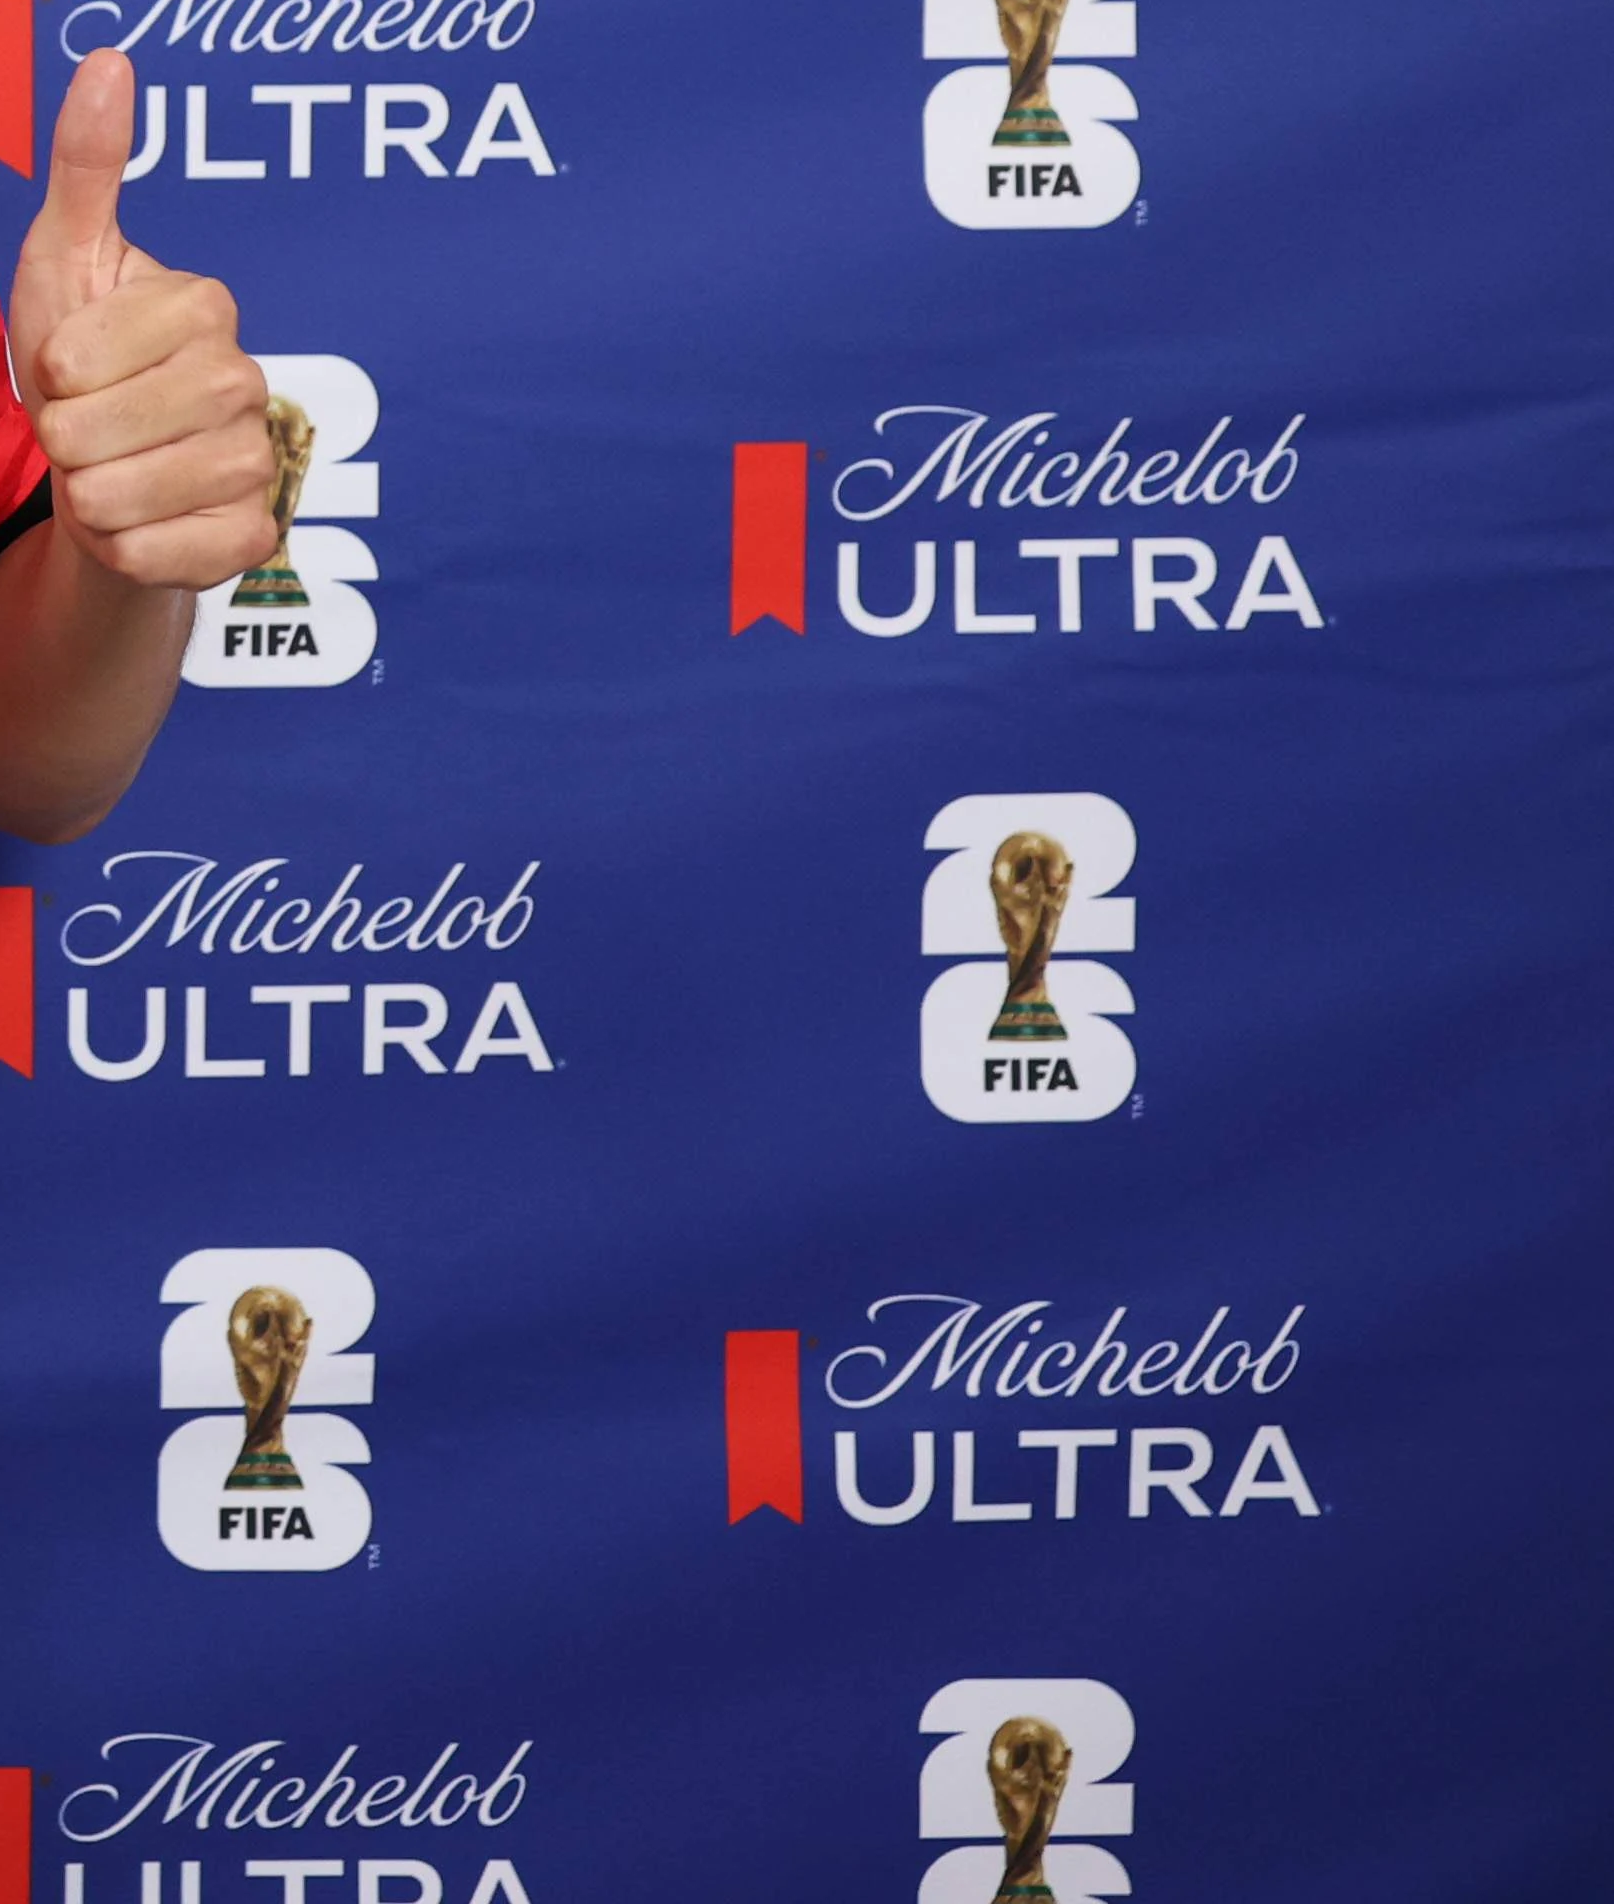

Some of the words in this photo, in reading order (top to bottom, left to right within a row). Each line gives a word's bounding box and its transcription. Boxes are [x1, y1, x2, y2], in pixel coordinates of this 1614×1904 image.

[988, 164, 1083, 198] FIFA
[831, 404, 1306, 522] Michelob
[836, 534, 1325, 638] ULTRA
[223, 623, 319, 657] FIFA
[60, 850, 541, 967] Michelob
[66, 981, 555, 1083] ULTRA
[984, 1057, 1079, 1092] FIFA
[824, 1293, 1306, 1410] Michelob
[218, 1506, 314, 1540] FIFA
[833, 1424, 1322, 1526] ULTRA
[58, 1732, 534, 1843] Michelob
